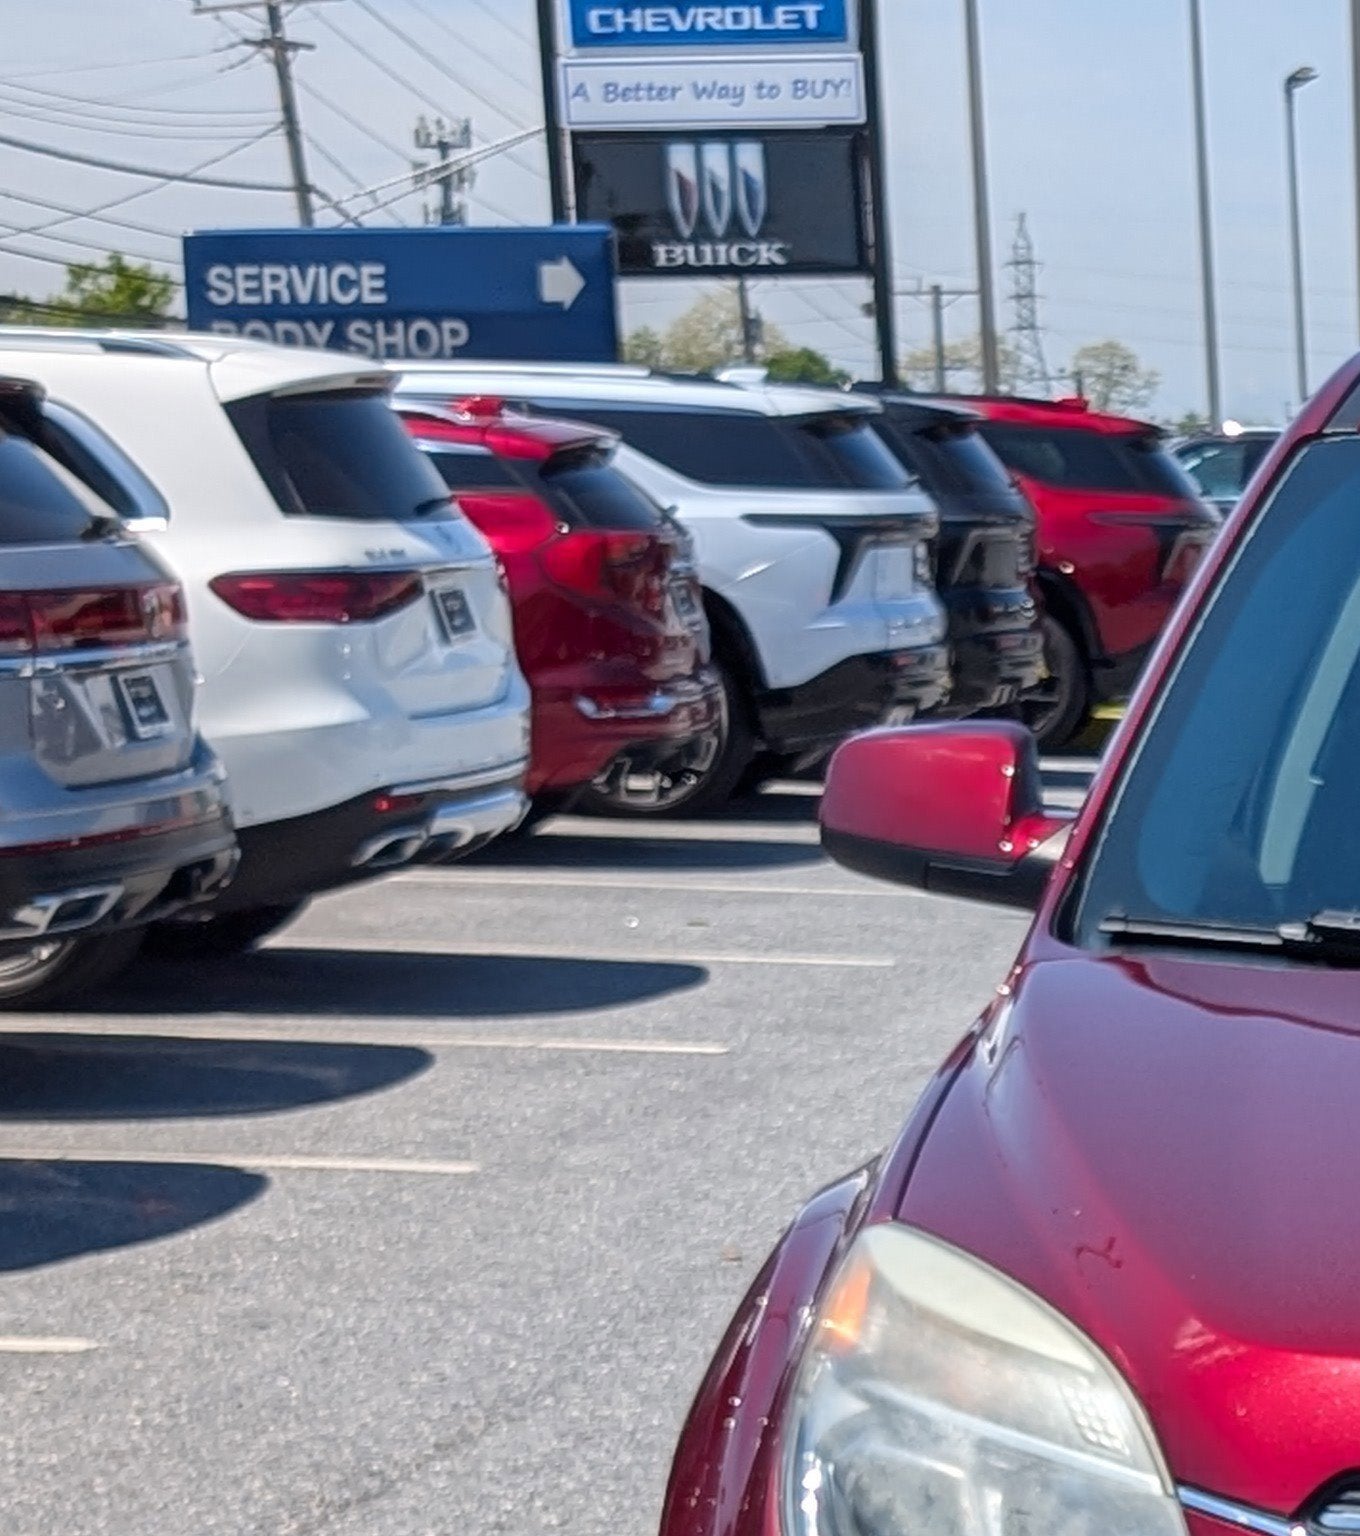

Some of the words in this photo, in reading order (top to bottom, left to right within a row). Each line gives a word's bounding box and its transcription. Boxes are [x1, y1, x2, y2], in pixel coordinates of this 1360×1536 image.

[588, 4, 825, 34] CHEVROLET
[571, 82, 591, 103] A
[603, 81, 683, 103] Better
[691, 79, 746, 107] Way
[754, 80, 782, 100] to
[791, 78, 851, 100] BUY!
[652, 242, 788, 268] BUICK
[206, 263, 388, 305] SERVICE
[346, 317, 470, 359] SHOP
